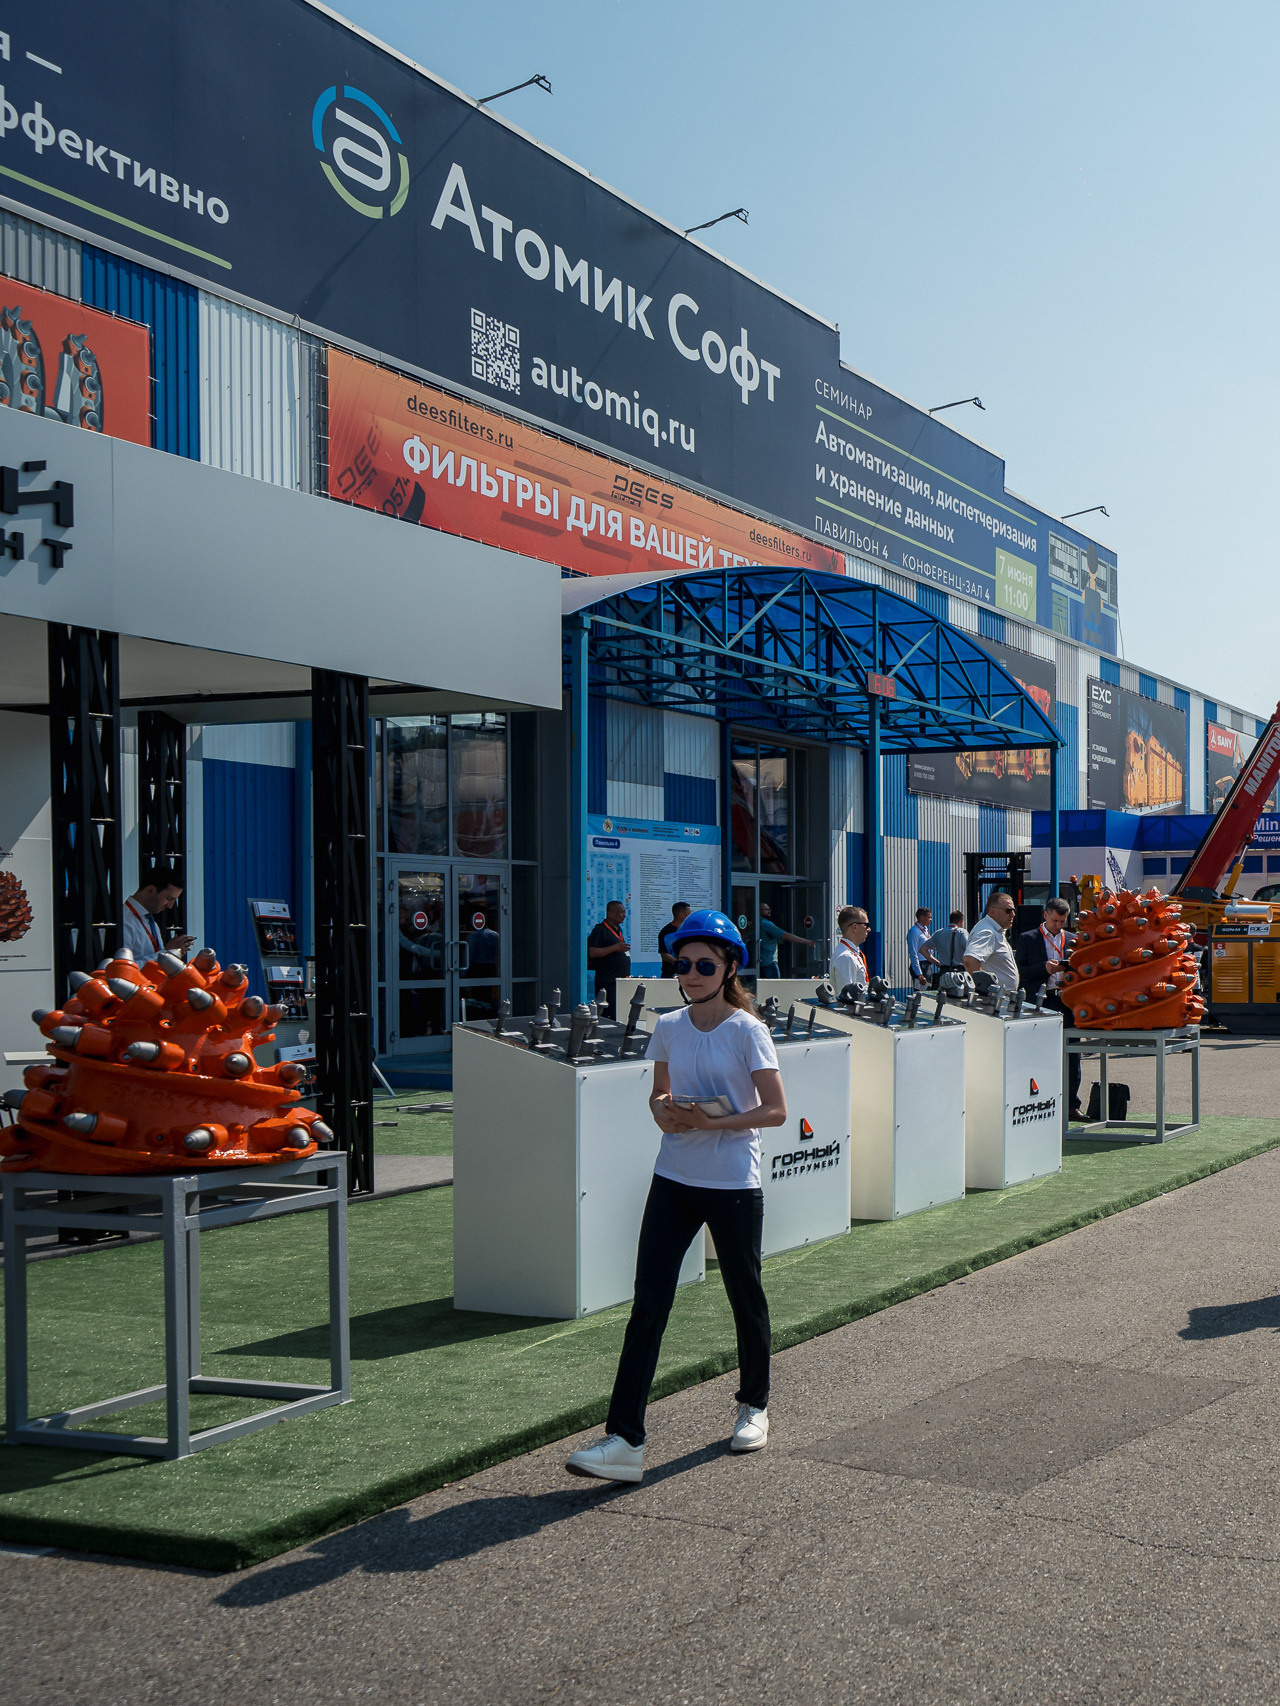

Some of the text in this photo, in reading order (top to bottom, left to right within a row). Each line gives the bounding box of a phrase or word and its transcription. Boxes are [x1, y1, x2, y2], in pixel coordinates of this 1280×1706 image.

[431, 163, 781, 405] Атомик Софт
[531, 356, 695, 453] automiq.ru
[815, 379, 873, 420] СЕМИНАР
[406, 395, 514, 449] deesfilters.ru
[403, 435, 559, 519] ФИЛЬТРЫ
[567, 497, 622, 540] ДЛЯ
[630, 516, 713, 569] ВАШЕЙ
[815, 421, 1037, 552] Автоматизация, диспетчеризация
[816, 463, 955, 543] и хранение данных
[750, 529, 812, 562] deesfilters.ru
[815, 516, 991, 602] ПАВИЛЬОН 4 КОНФЕРЕНЦ-ЗАЛ 4
[999, 555, 1033, 588] 7 июня
[1004, 584, 1029, 612] 11:00
[1091, 685, 1112, 704] EXC
[1217, 735, 1232, 749] SANY
[1012, 1097, 1056, 1117] ГОРНЫЙ
[1012, 1111, 1056, 1126] ИНСТРУМЕНТ
[772, 1140, 840, 1169] ГОРНЫЙ
[772, 1158, 840, 1180] ИНСТРУМЕНТ
